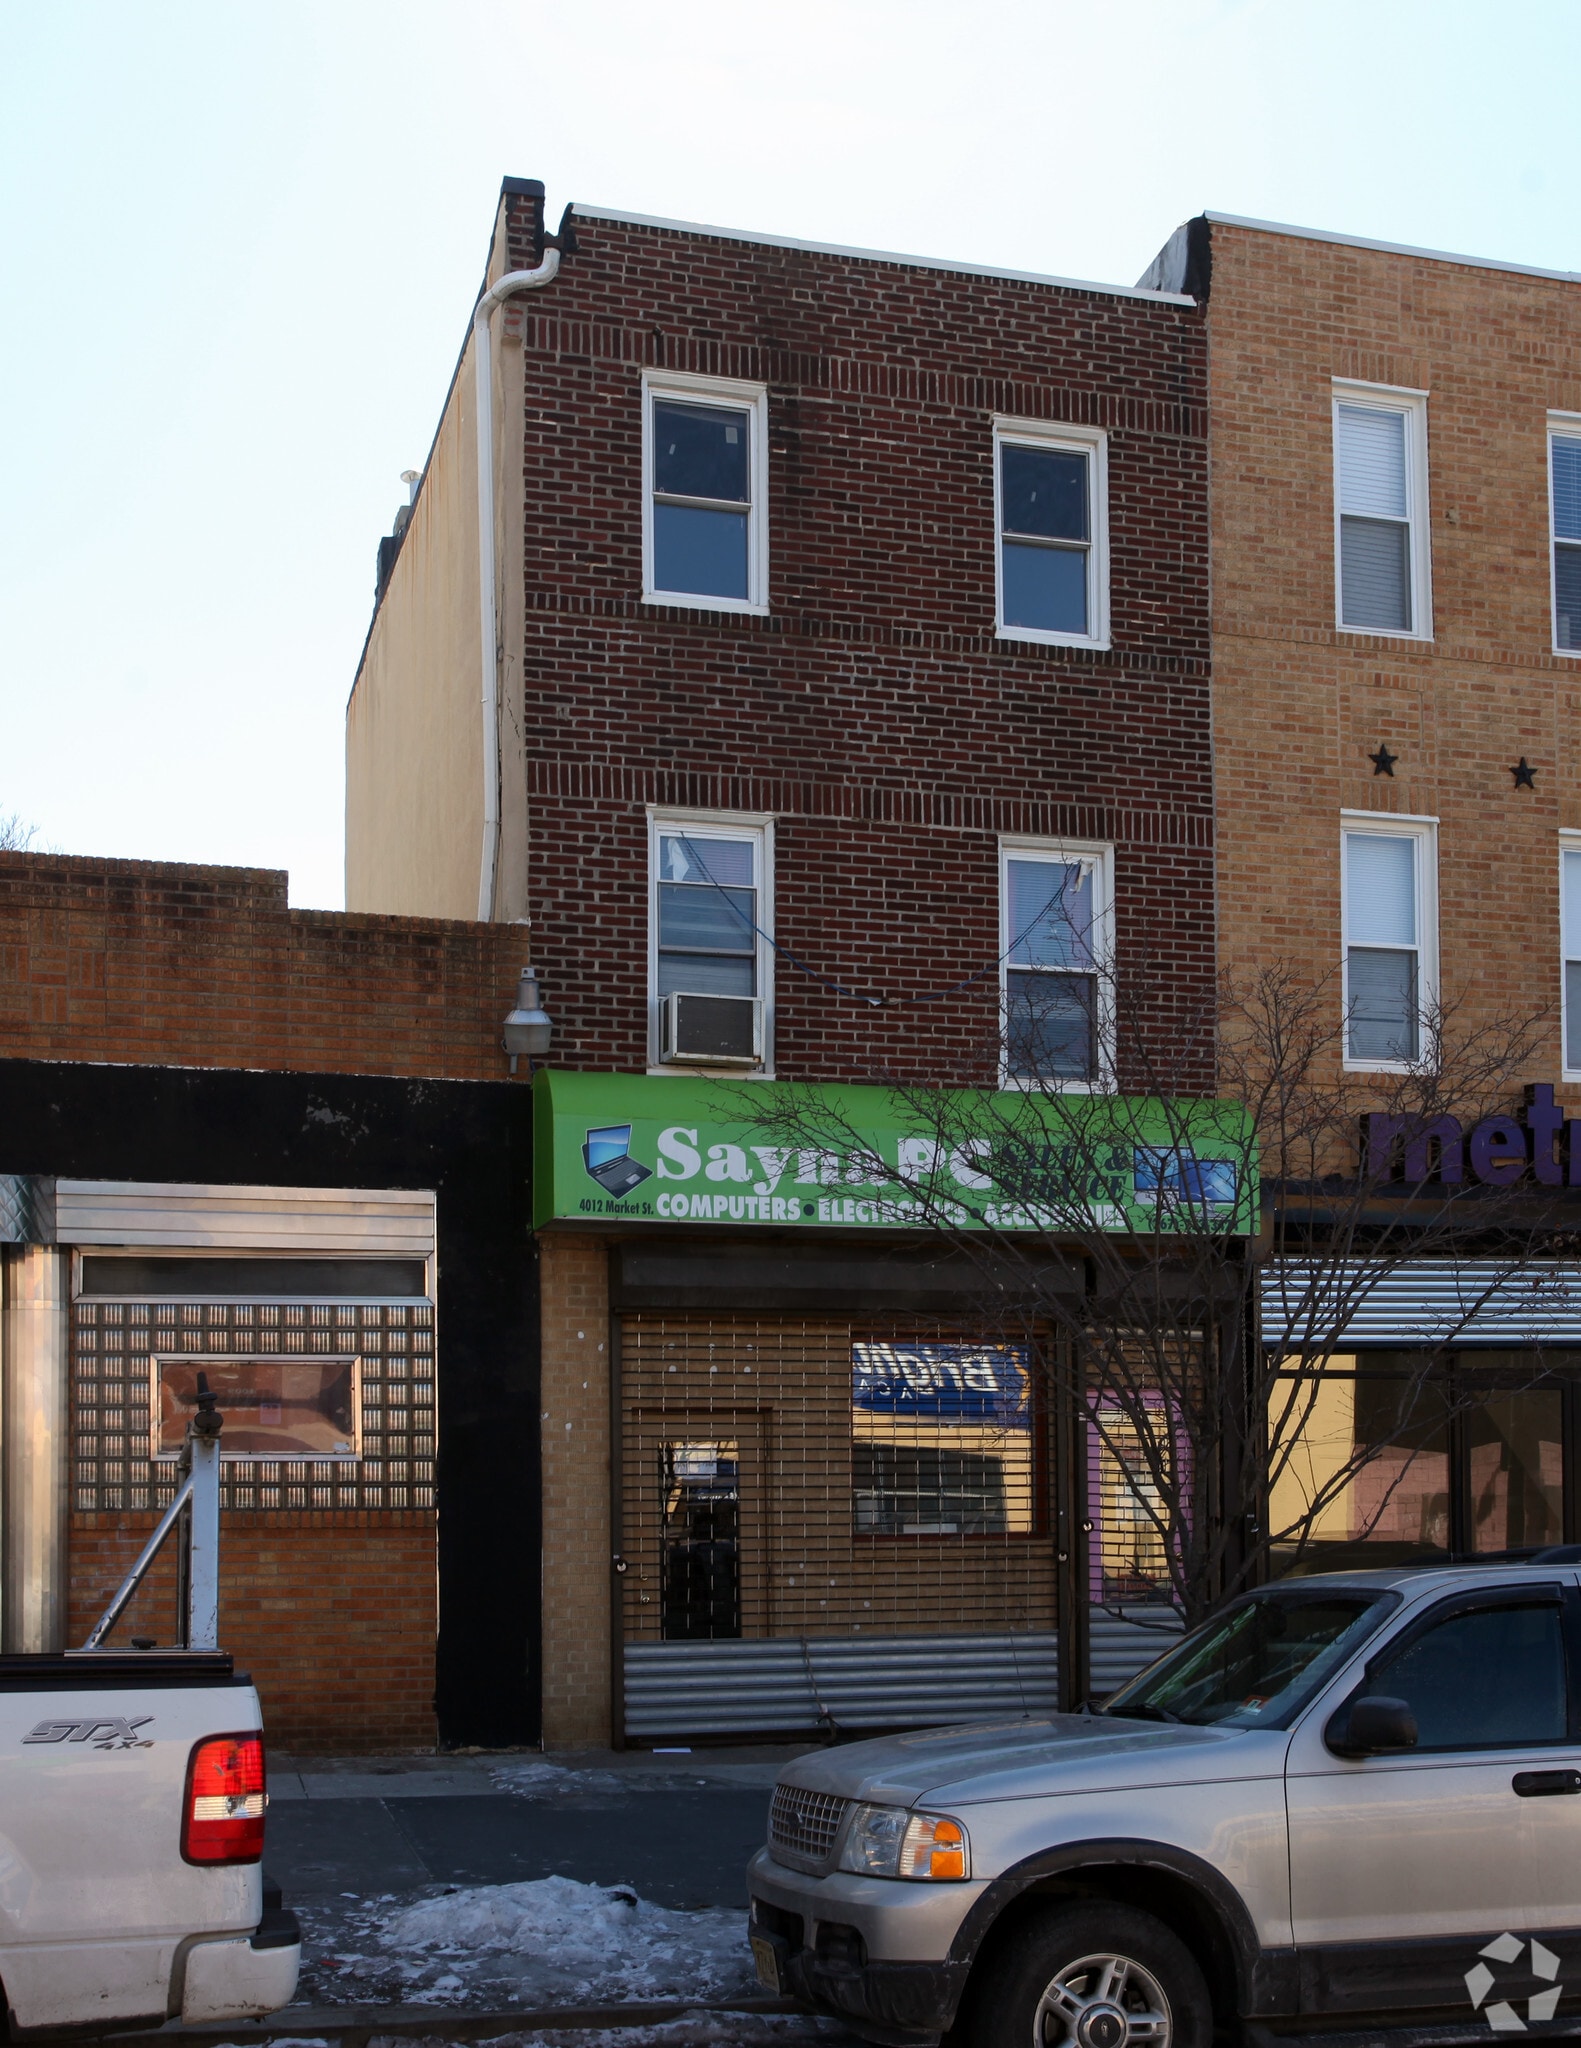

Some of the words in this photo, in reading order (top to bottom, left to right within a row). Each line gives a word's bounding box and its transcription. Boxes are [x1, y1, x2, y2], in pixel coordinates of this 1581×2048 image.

[656, 1127, 890, 1195] Sayna
[897, 1138, 993, 1190] PC
[579, 1198, 603, 1213] 4012
[605, 1200, 640, 1214] Market
[642, 1202, 655, 1215] St.
[656, 1193, 800, 1220] COMPUTERS
[818, 1199, 967, 1226] ELECTRONICS
[21, 1716, 155, 1743] STX
